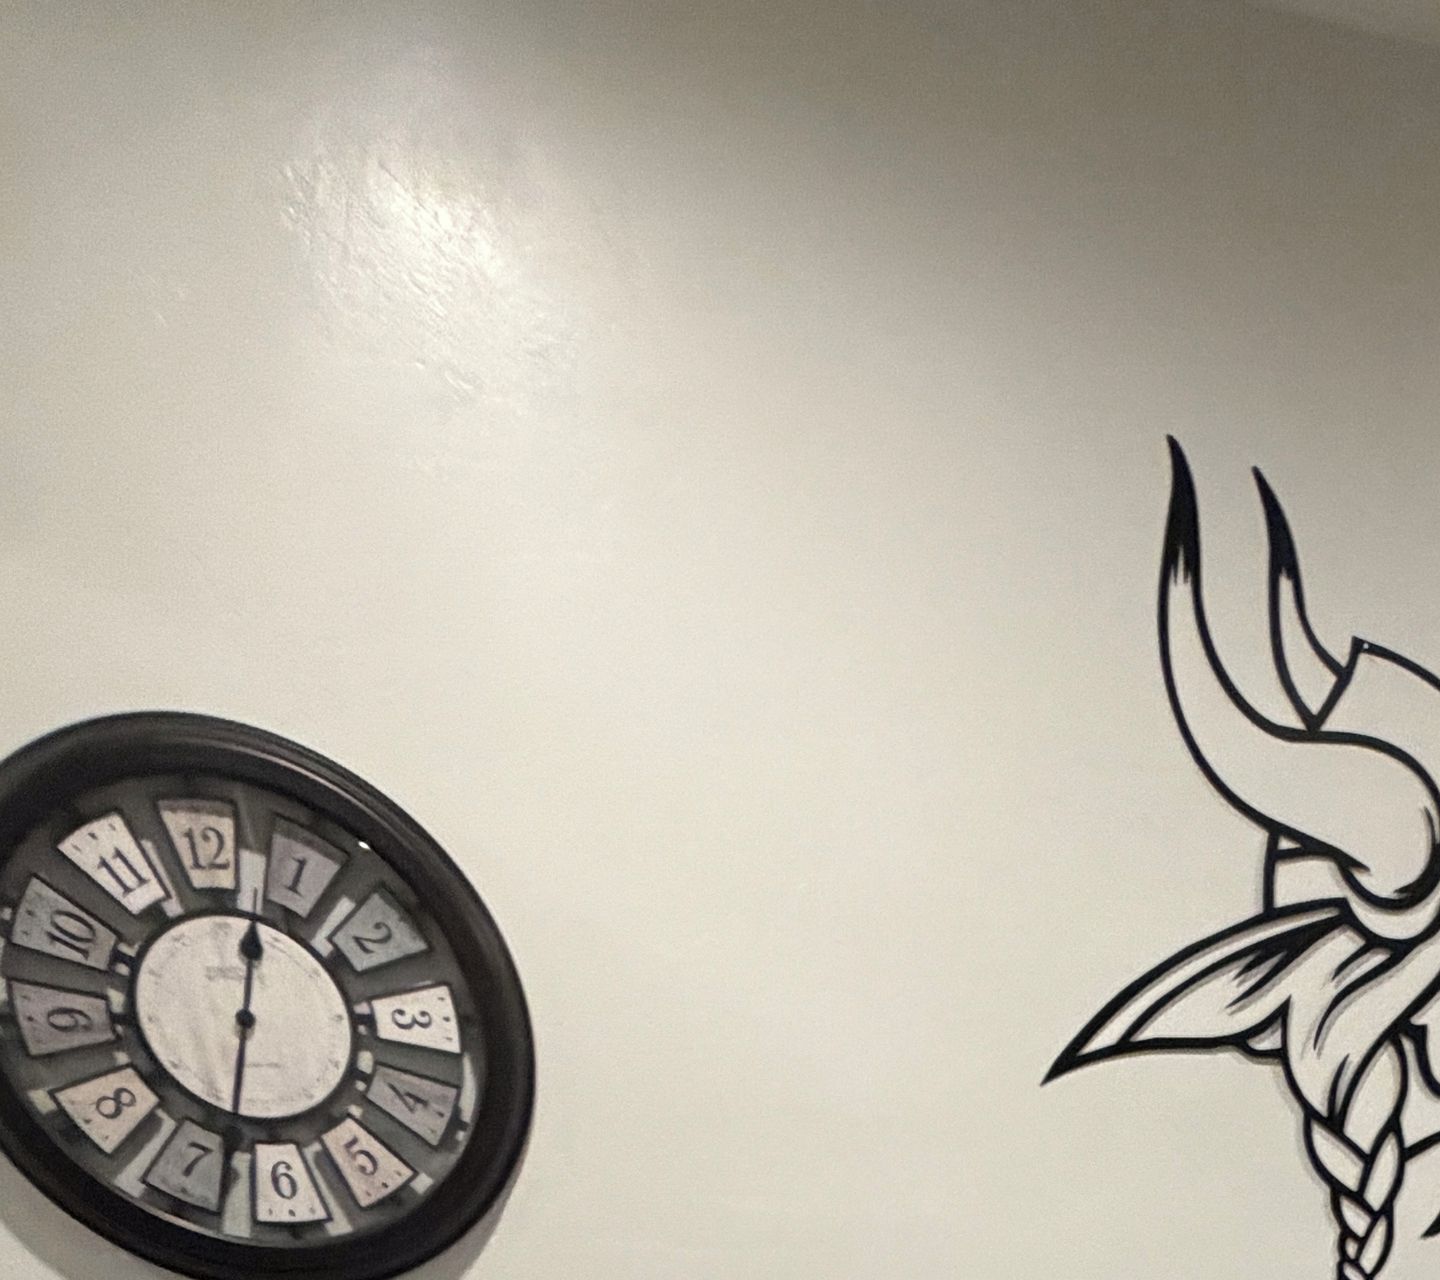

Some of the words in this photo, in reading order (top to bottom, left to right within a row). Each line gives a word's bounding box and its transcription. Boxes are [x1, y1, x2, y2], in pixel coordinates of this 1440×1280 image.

[184, 826, 230, 870] 12
[97, 847, 149, 897] 11
[283, 857, 308, 897] 1
[45, 909, 96, 961] 10
[352, 922, 392, 954] 2
[47, 1006, 94, 1032] 9
[391, 1008, 432, 1030] 3
[96, 1087, 136, 1120] 8
[385, 1082, 429, 1114] 4
[182, 1141, 213, 1178] 7
[343, 1134, 379, 1176] 5
[270, 1161, 298, 1200] 6
